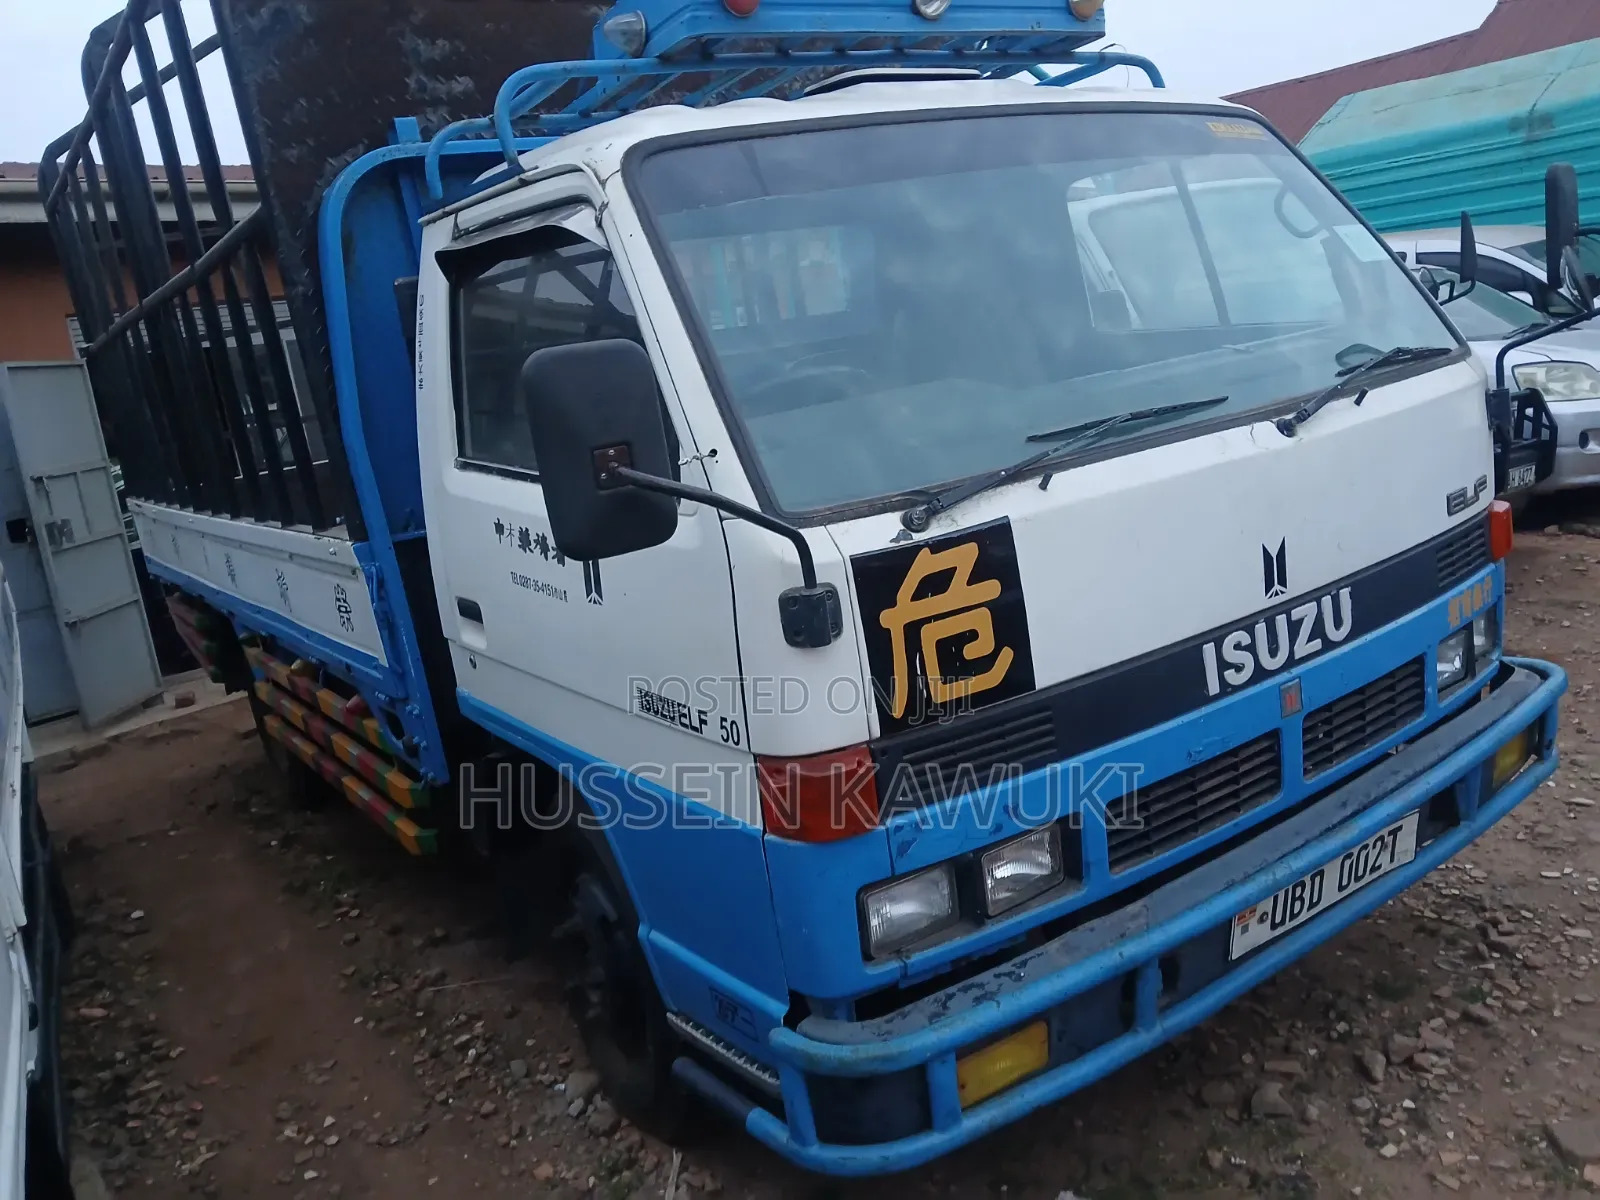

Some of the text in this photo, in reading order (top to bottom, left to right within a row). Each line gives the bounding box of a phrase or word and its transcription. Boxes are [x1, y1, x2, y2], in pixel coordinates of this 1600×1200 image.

[1446, 474, 1488, 517] ELF
[879, 541, 1014, 719] 危
[1202, 587, 1352, 696] ISUZU
[636, 687, 740, 746] ISUZU ELF 50
[1270, 824, 1403, 931] UBD 002T
